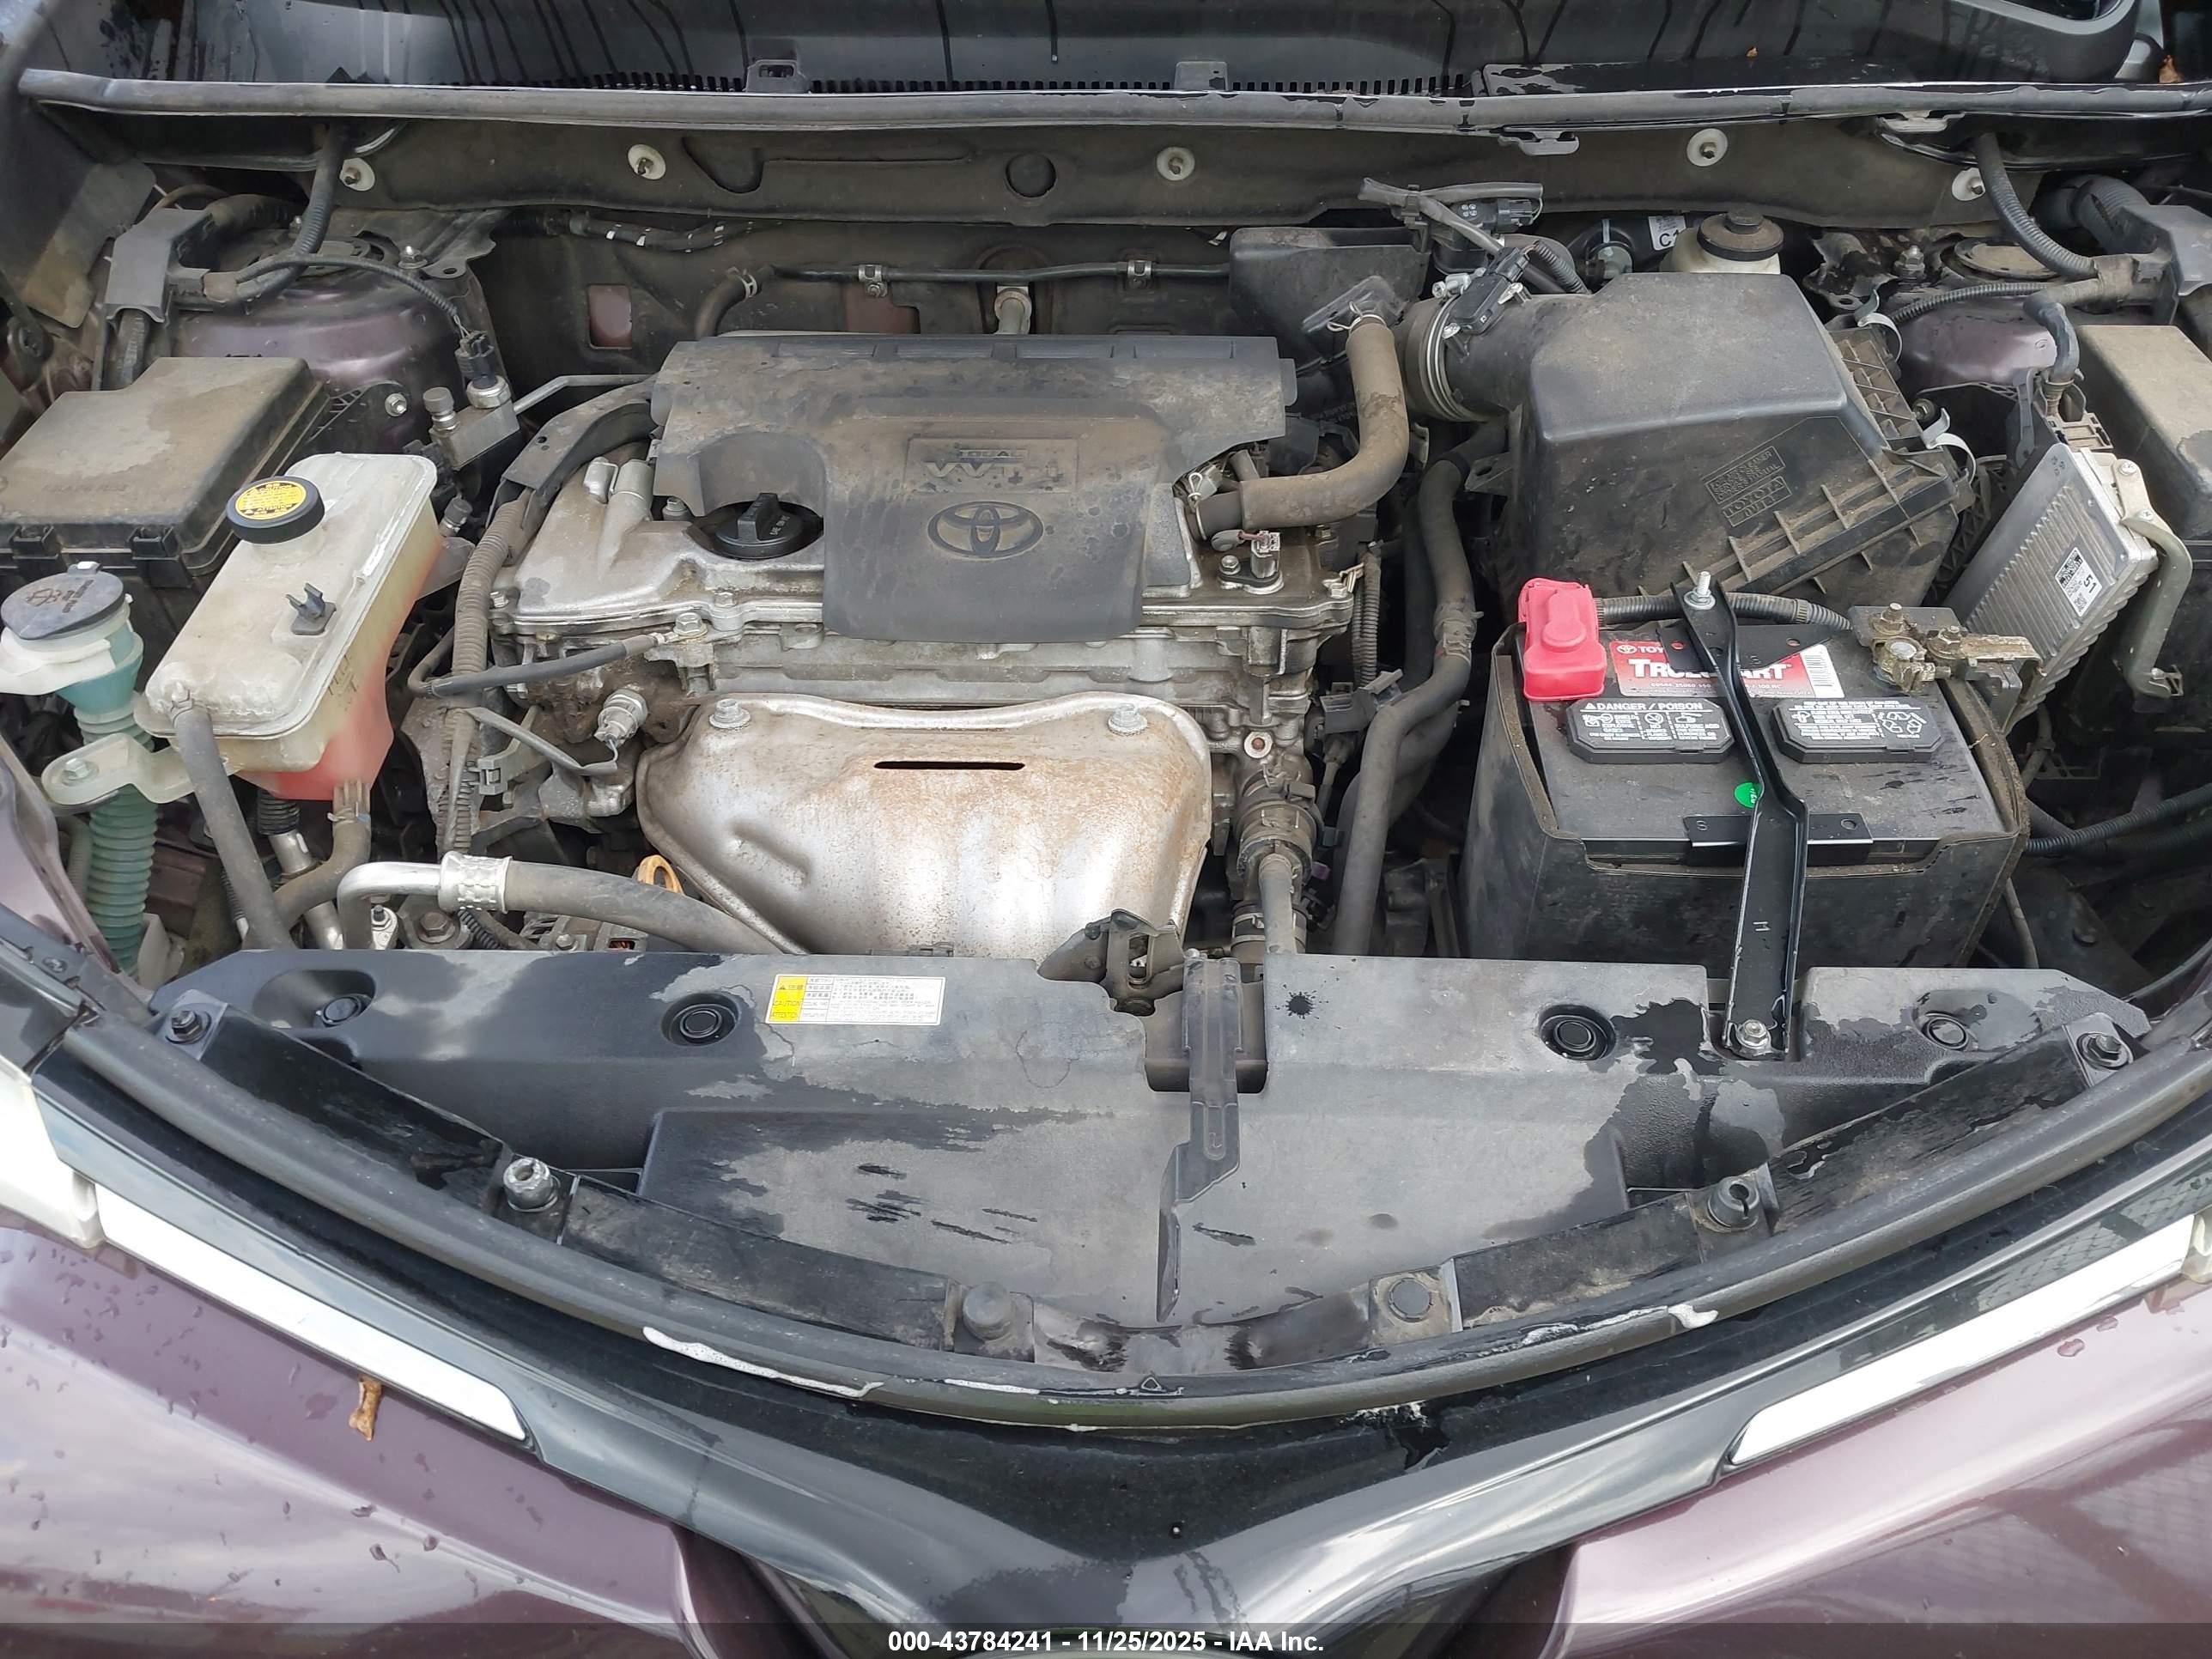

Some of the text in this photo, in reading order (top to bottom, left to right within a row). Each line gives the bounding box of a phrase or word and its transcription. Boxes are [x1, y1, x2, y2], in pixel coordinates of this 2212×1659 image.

[2083, 574, 2097, 594] 51
[1638, 646, 1664, 654] TOY
[1597, 702, 1647, 711] DANGER
